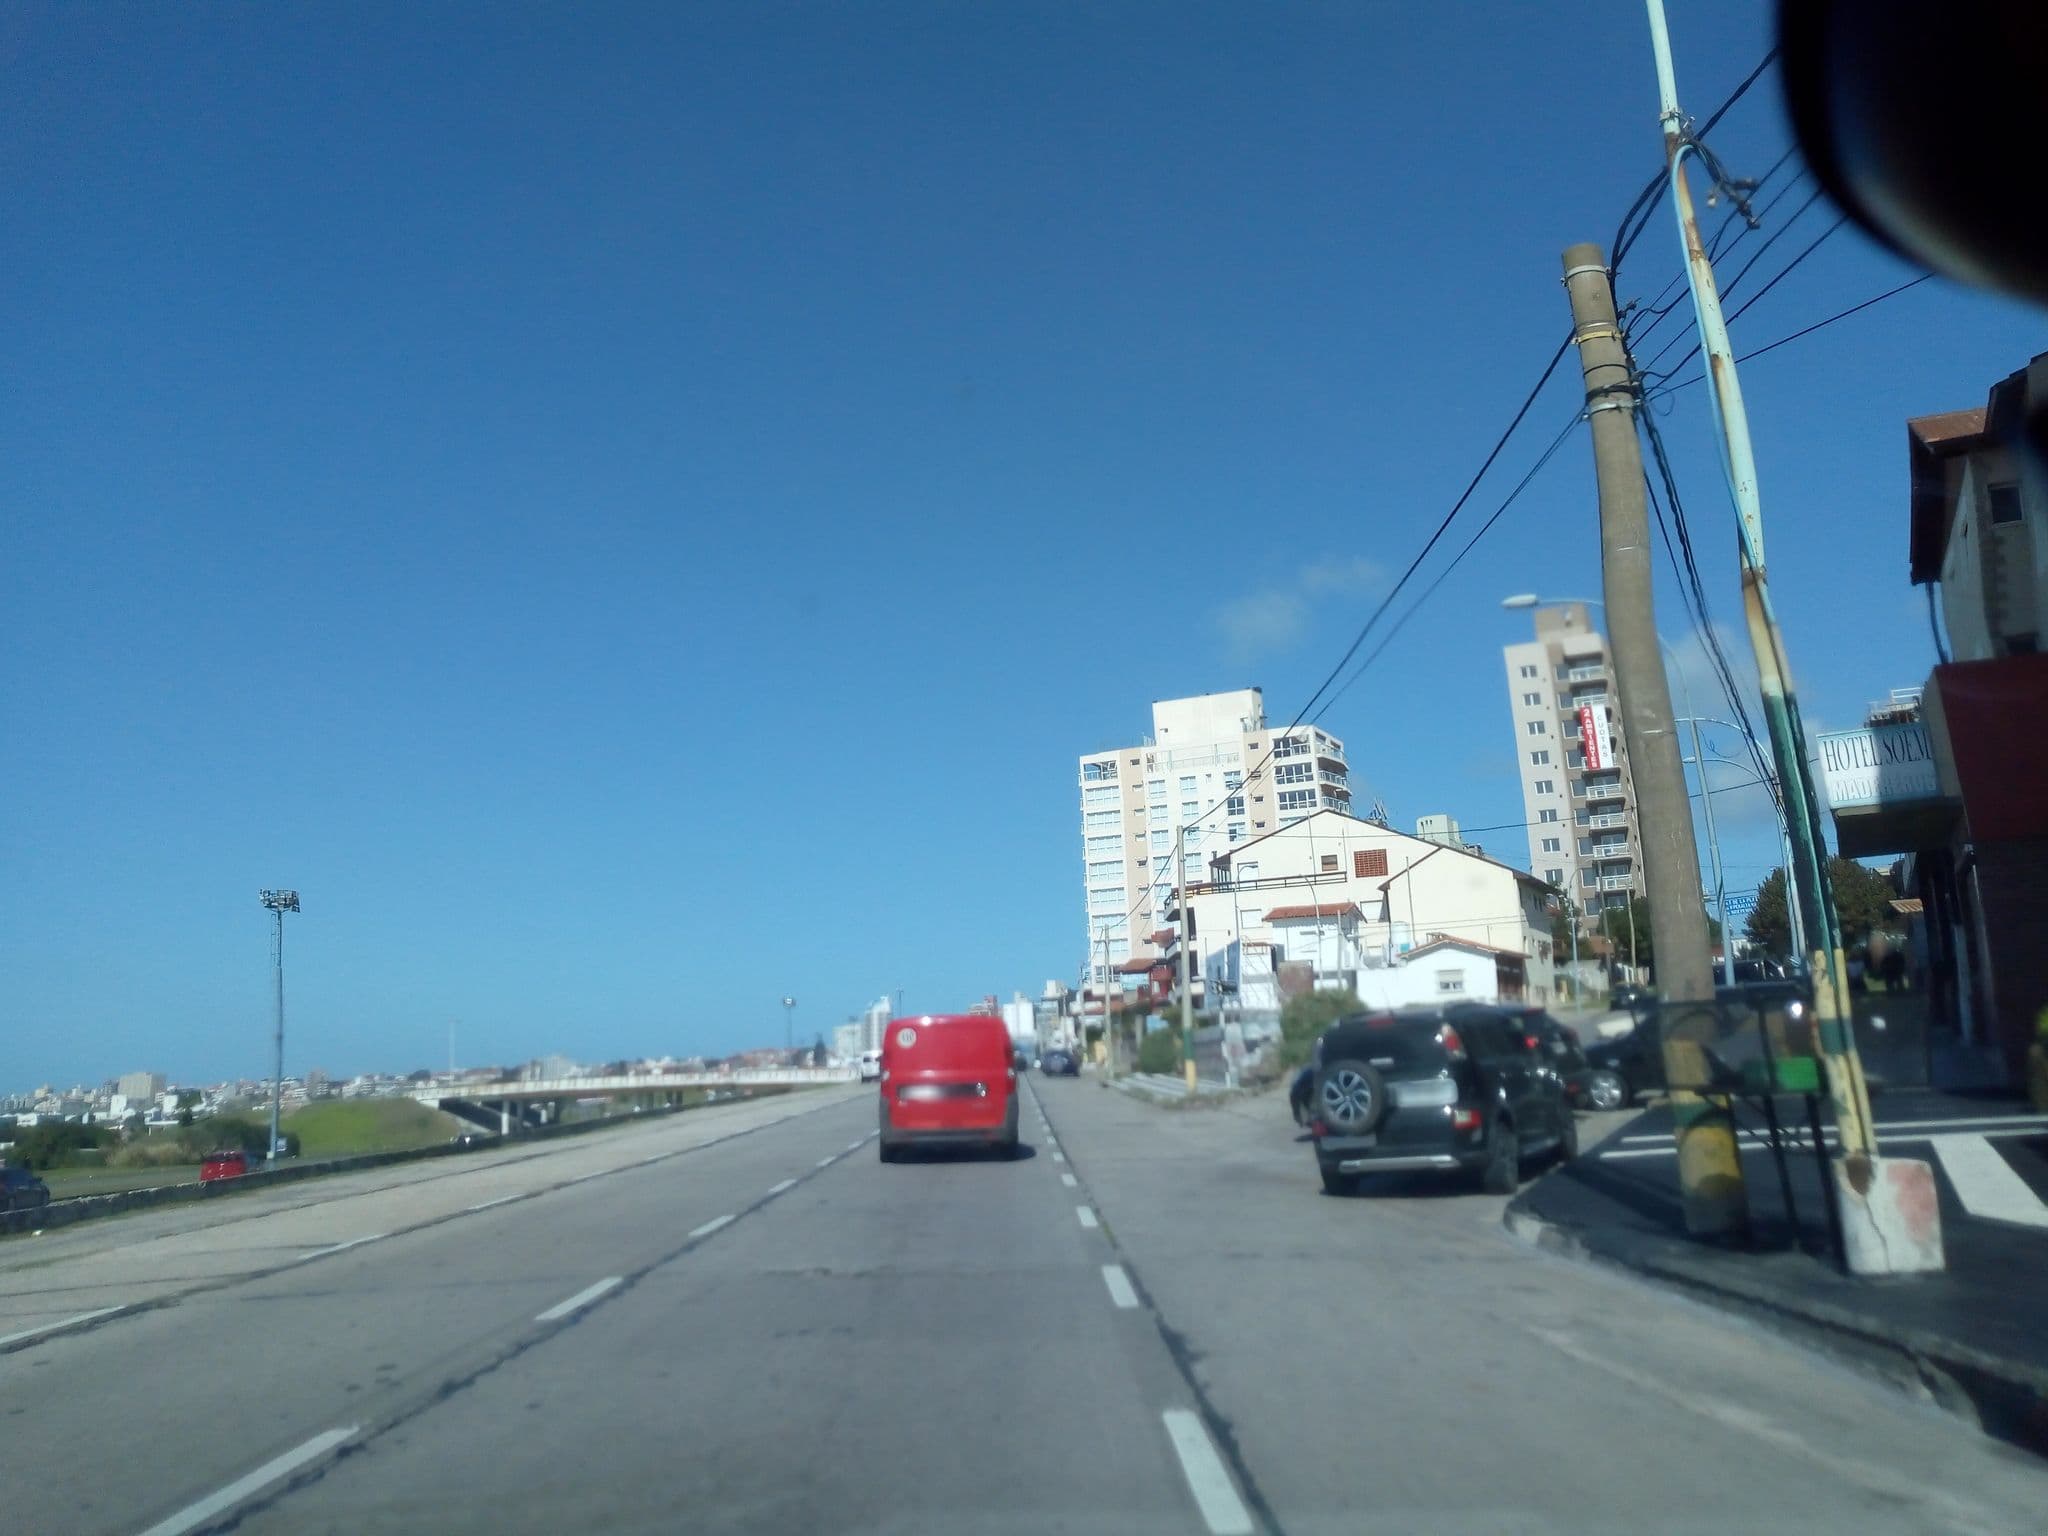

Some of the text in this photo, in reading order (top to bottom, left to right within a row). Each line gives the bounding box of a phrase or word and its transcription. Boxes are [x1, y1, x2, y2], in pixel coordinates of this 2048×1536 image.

[1583, 708, 1591, 716] 2
[1598, 715, 1608, 757] CUOTAS
[1823, 734, 1883, 771] HOTEL
